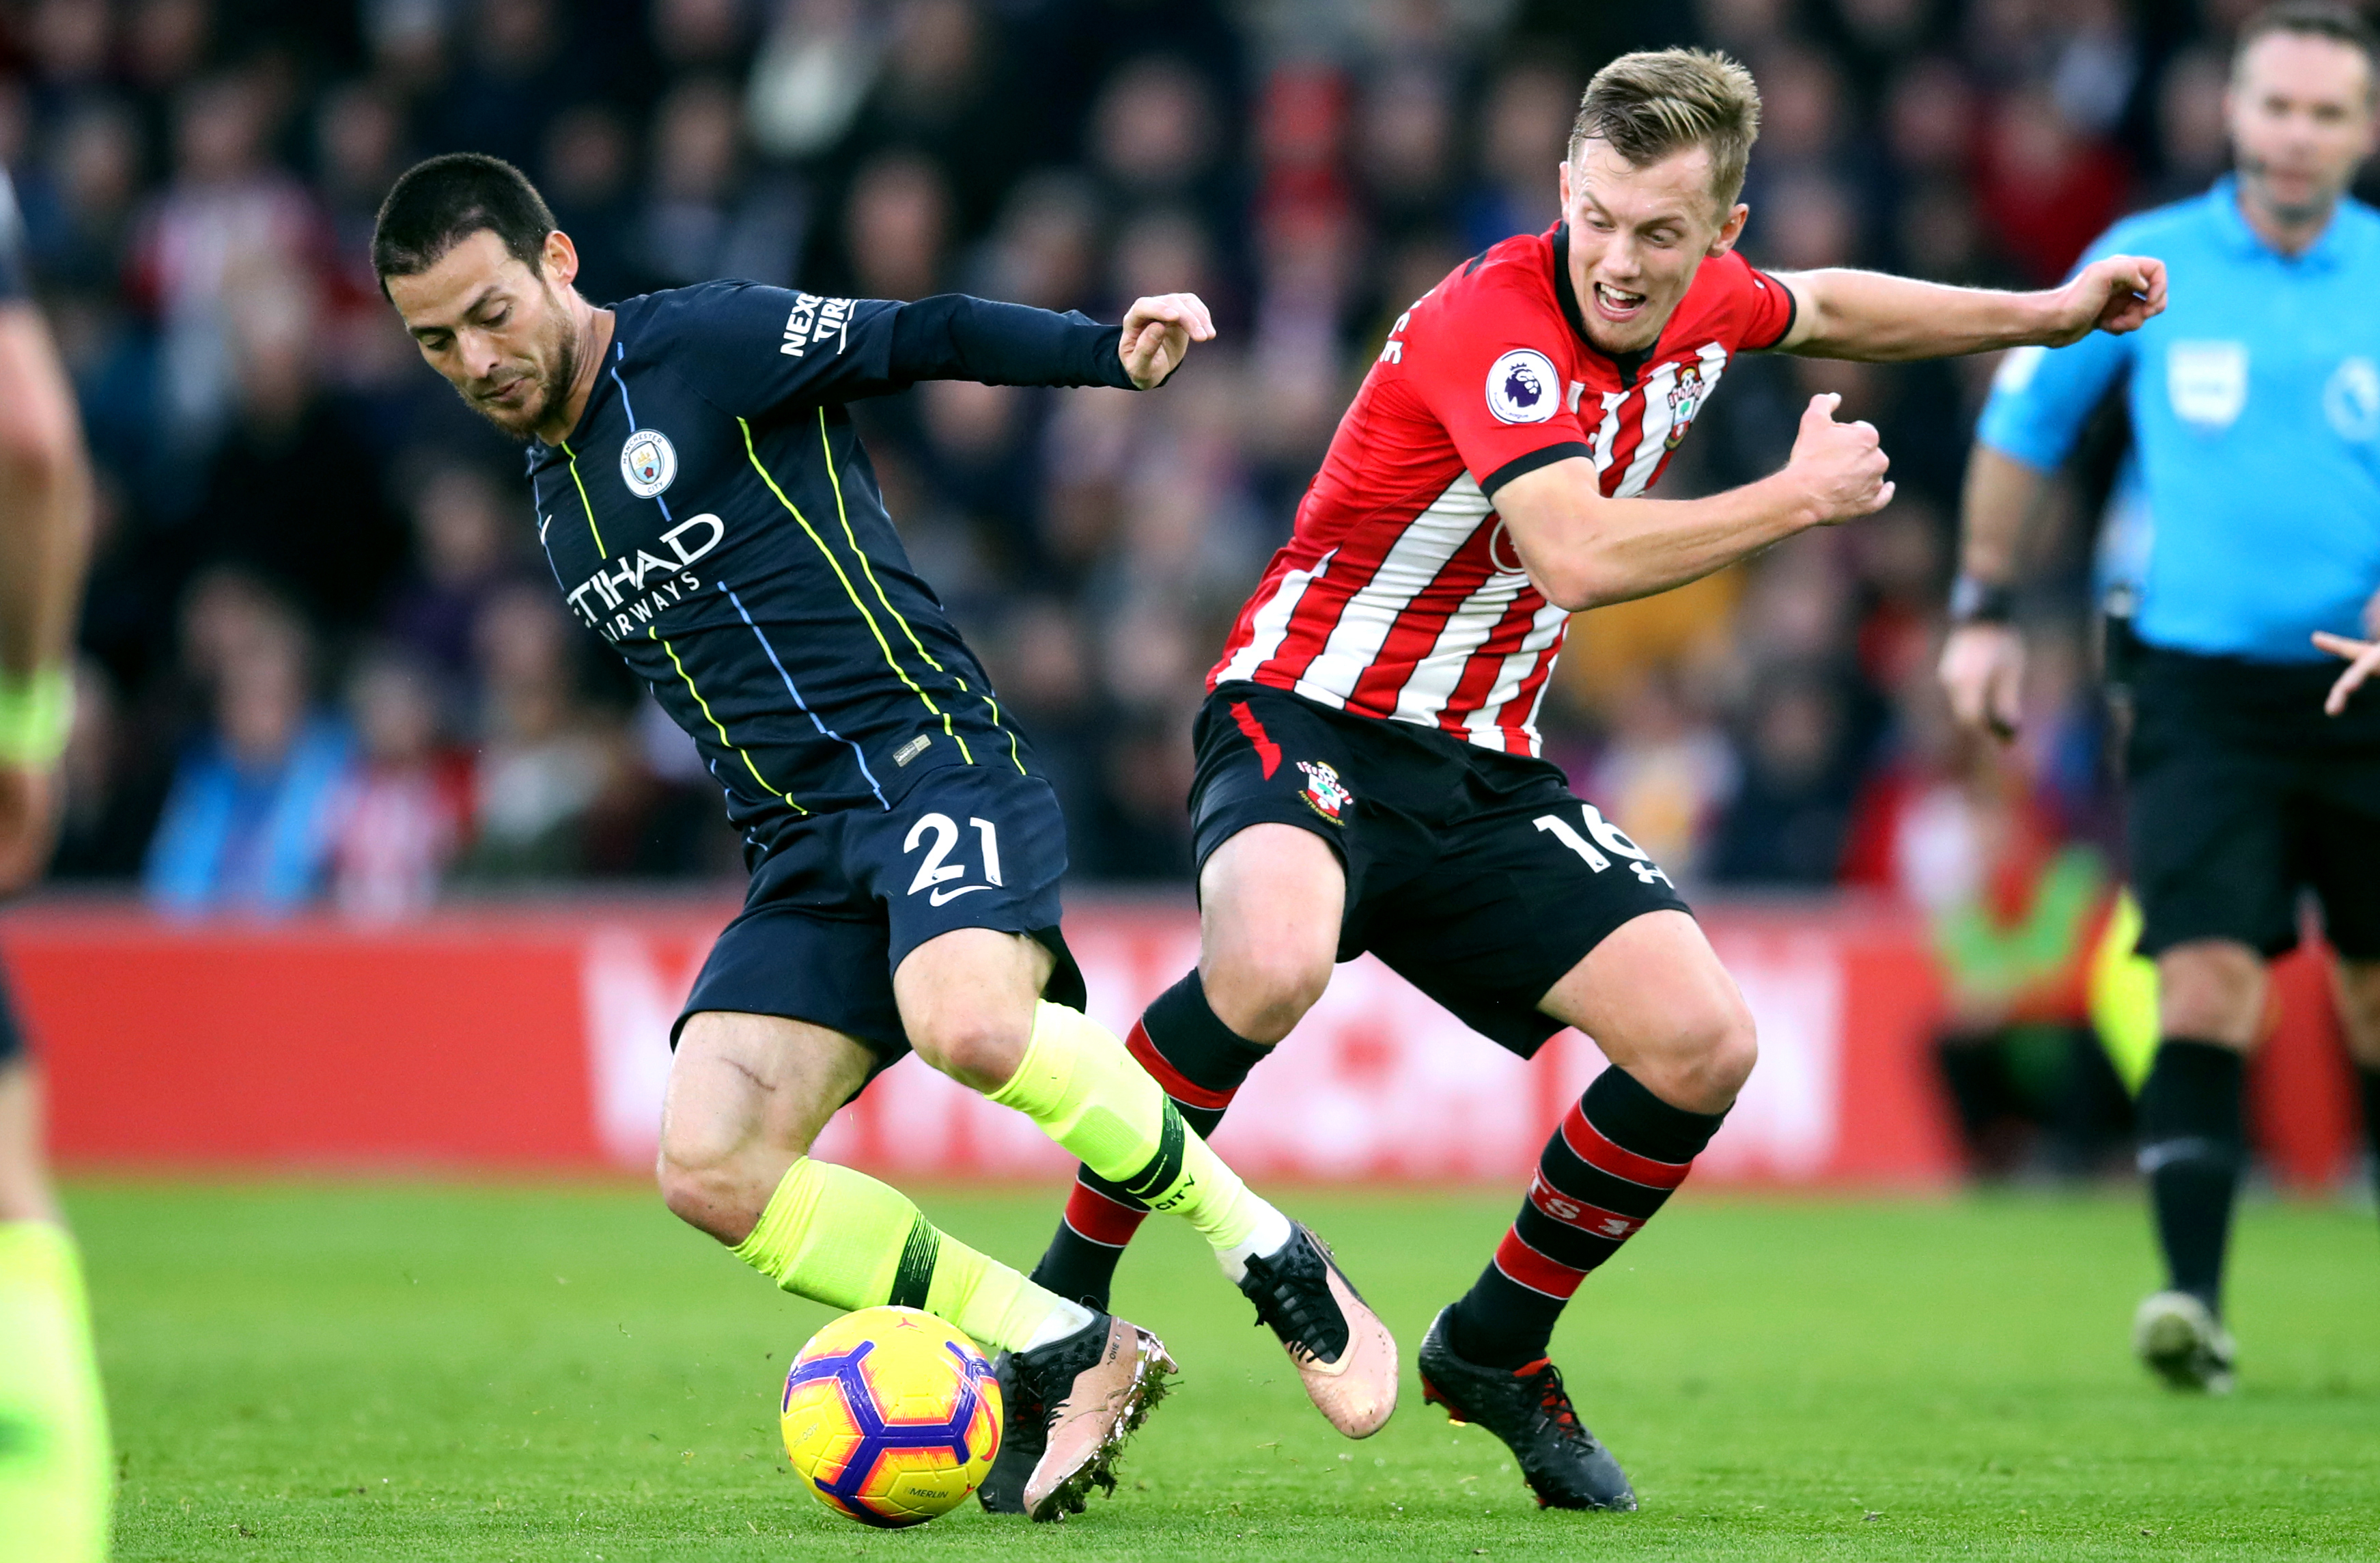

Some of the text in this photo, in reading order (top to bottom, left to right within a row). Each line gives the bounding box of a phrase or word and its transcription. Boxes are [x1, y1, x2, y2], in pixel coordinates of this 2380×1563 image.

[623, 433, 662, 465] MANCHESTER
[647, 481, 664, 493] CITY
[567, 513, 725, 628] TIHAD
[903, 812, 1003, 896] 21
[1532, 803, 1651, 874] 16
[1155, 1173, 1195, 1211] CITY
[909, 1487, 949, 1499] MERLIN
